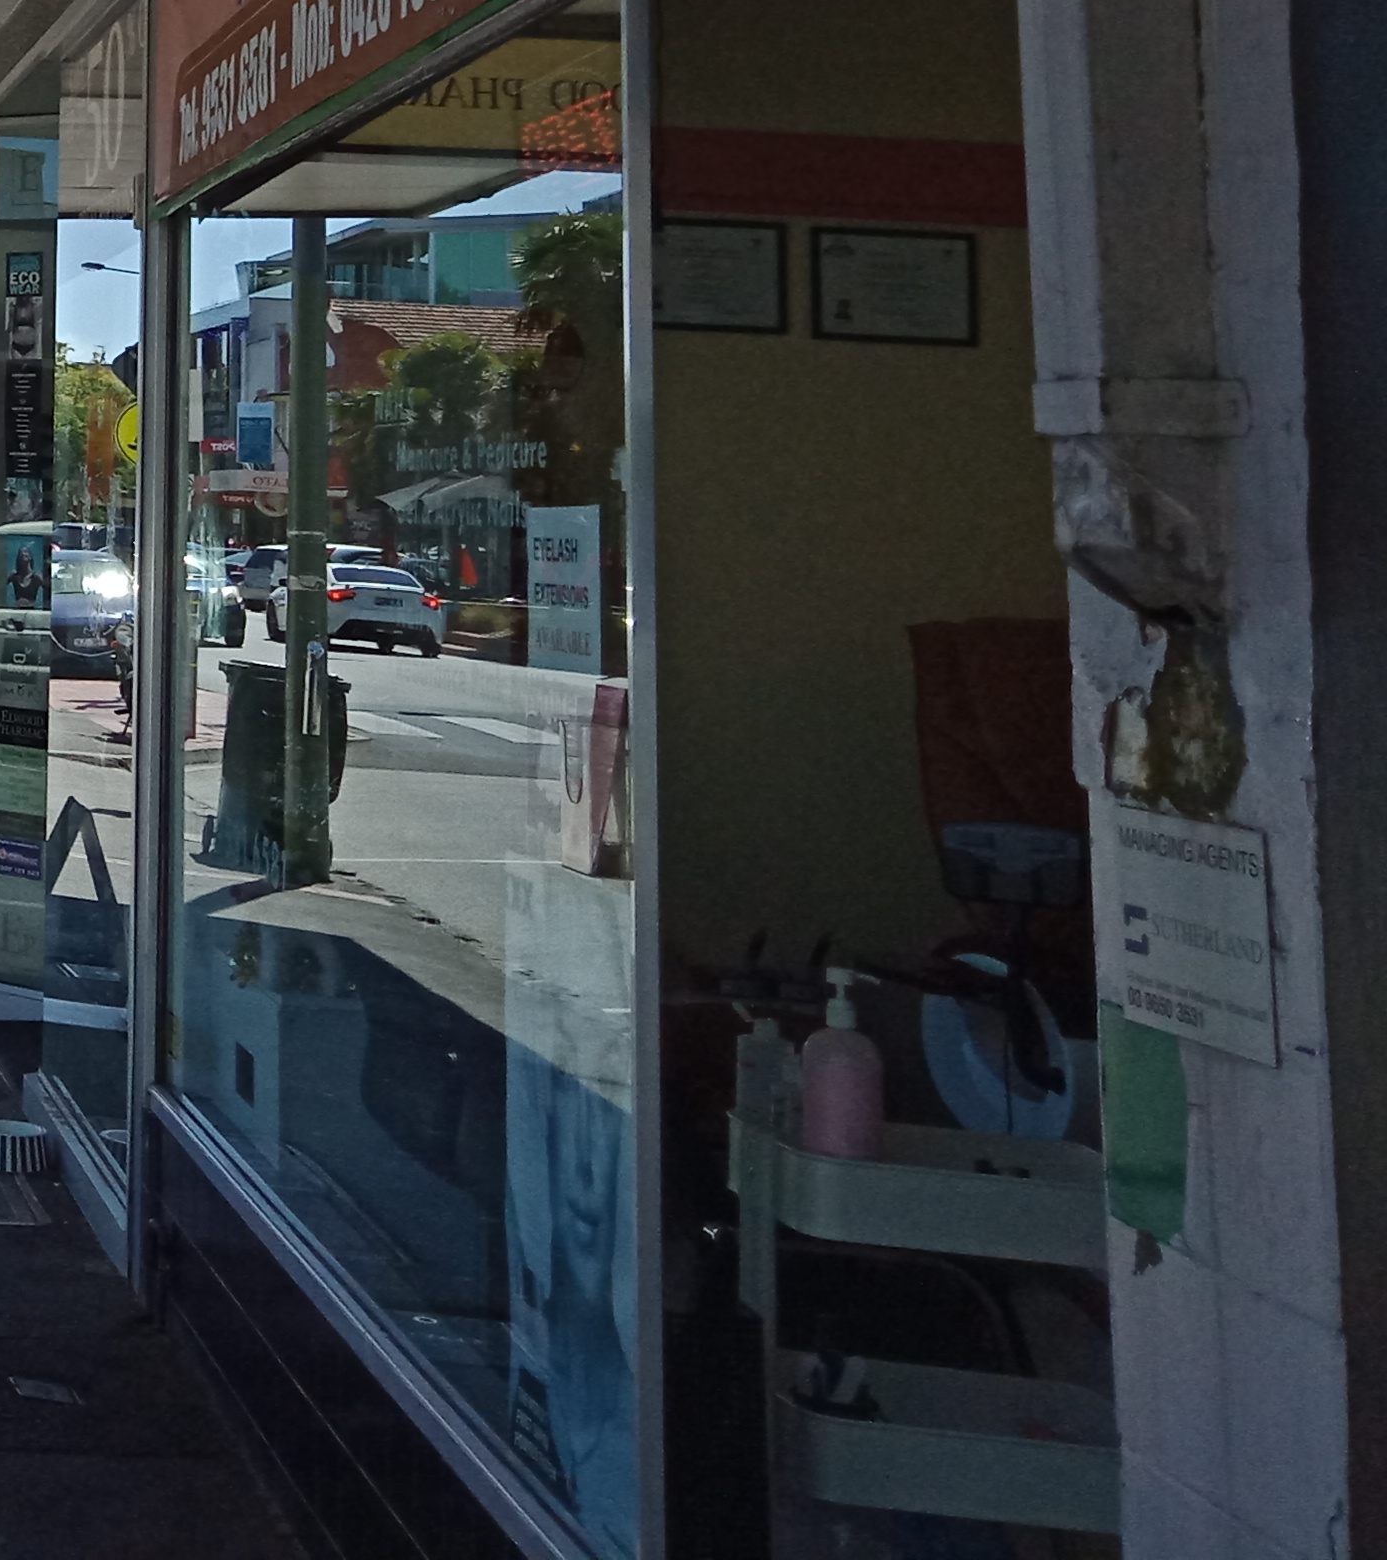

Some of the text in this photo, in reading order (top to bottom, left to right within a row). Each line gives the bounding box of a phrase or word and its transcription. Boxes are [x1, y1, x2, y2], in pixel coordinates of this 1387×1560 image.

[10, 271, 40, 285] ECO
[10, 284, 40, 295] WEAR
[396, 439, 458, 472] Manicure
[476, 431, 548, 470] Pedicure
[534, 537, 578, 563] EYELASH
[534, 583, 589, 610] EXTENSIONS
[1118, 825, 1259, 878] MANAGING AGENTS
[1151, 913, 1264, 964] SUTHERLAND
